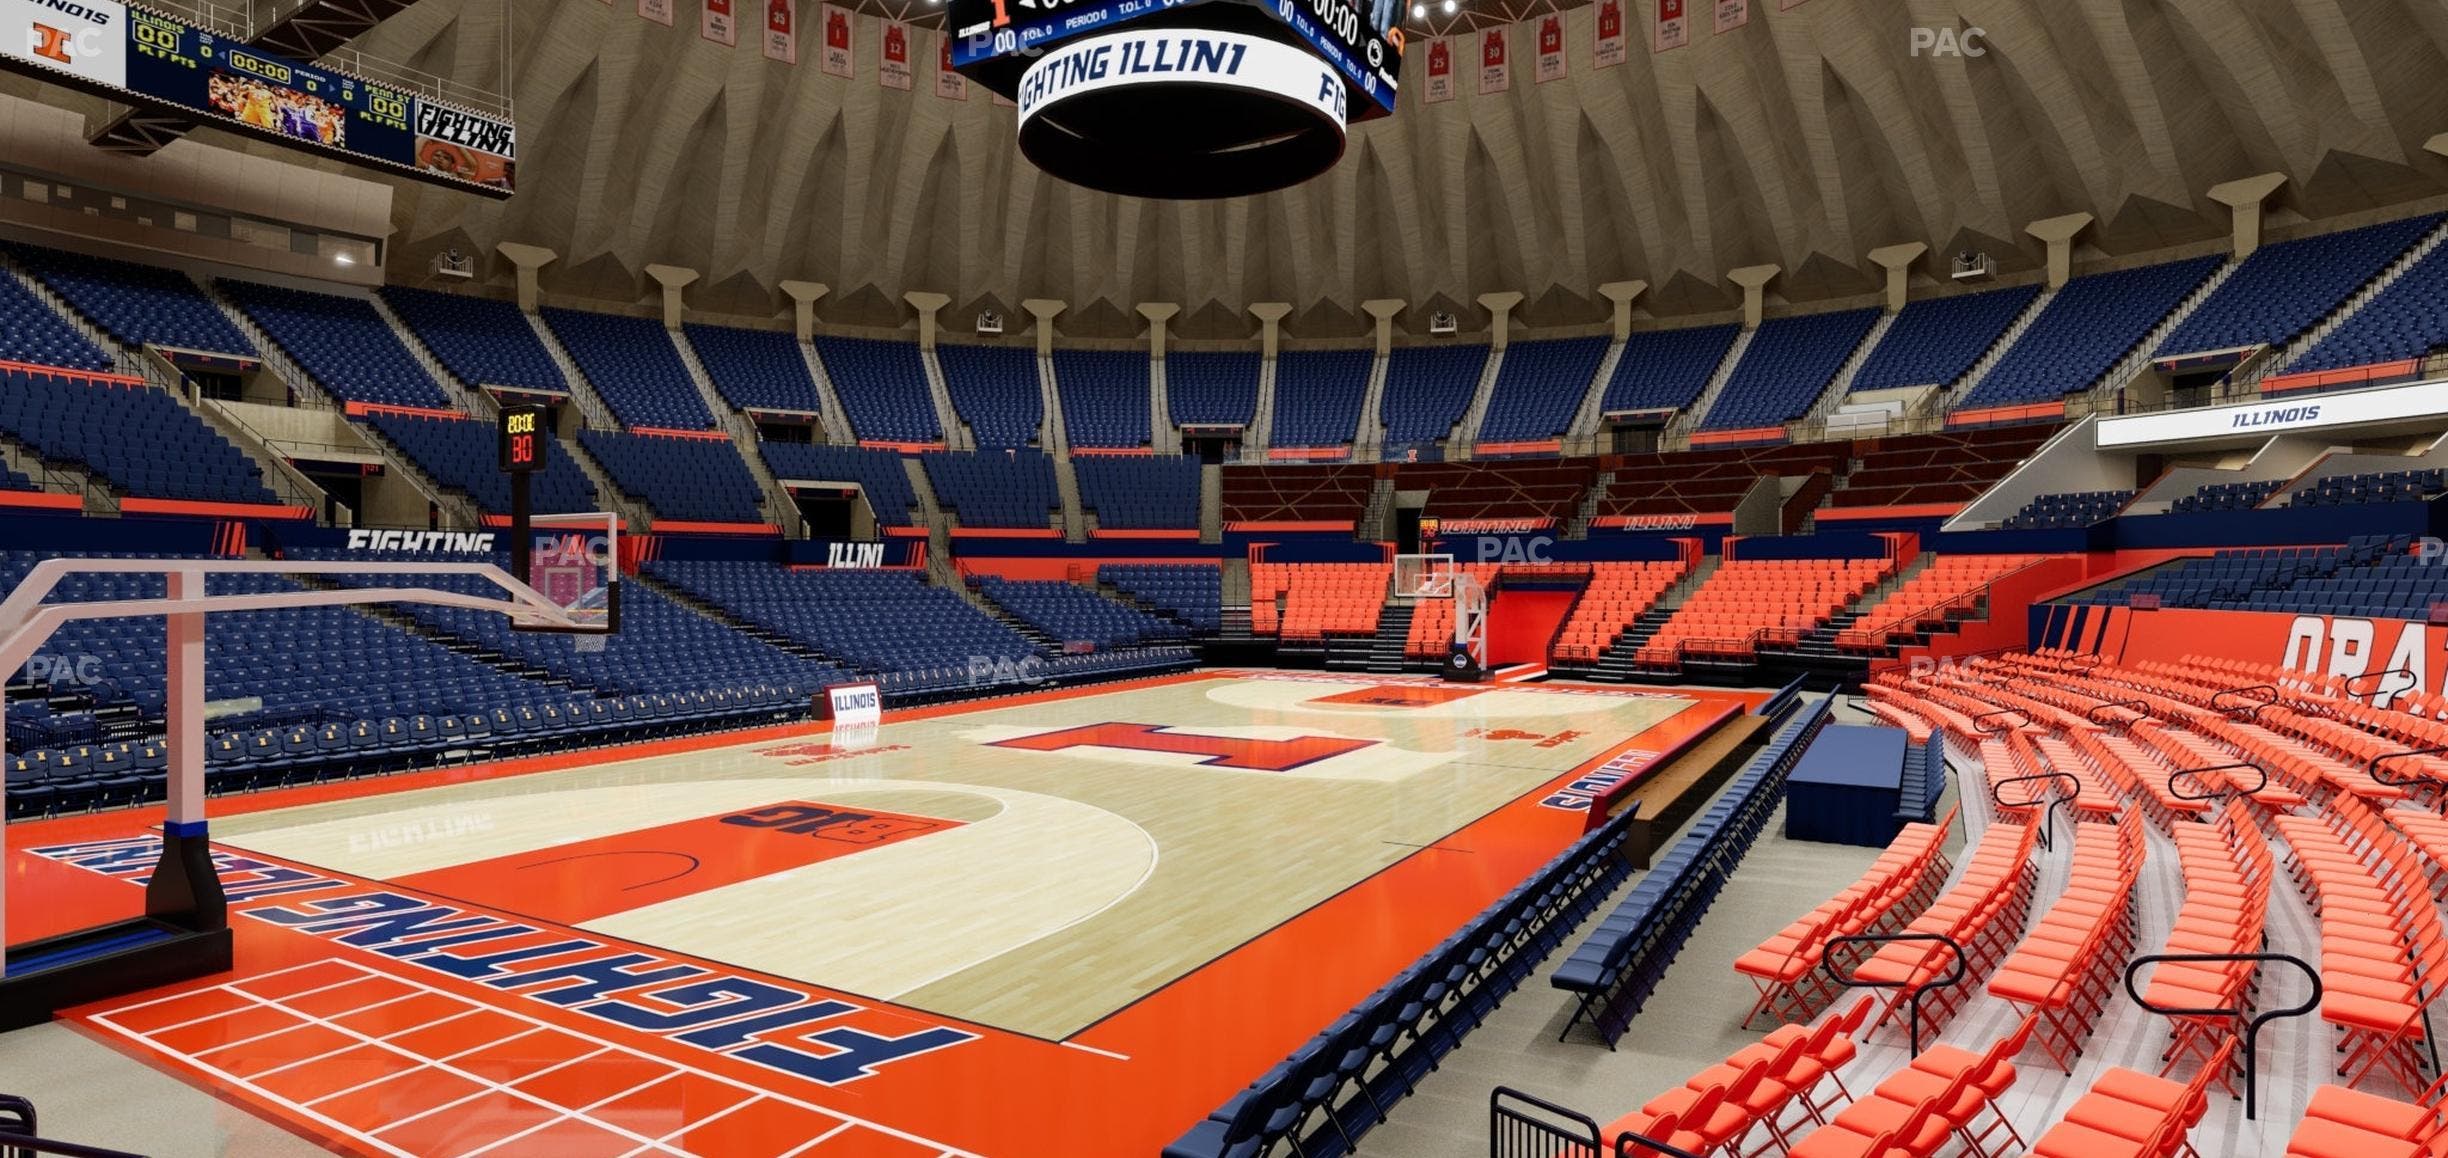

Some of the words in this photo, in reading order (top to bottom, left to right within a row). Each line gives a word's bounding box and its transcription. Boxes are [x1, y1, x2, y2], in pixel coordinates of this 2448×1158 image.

[131, 10, 185, 34] ILLINOIS
[1065, 11, 1099, 29] PERIOD
[136, 23, 176, 49] 00
[995, 29, 1016, 52] 00
[233, 54, 288, 81] 00:00
[1119, 39, 1247, 76] ILLINI
[295, 69, 326, 82] PERIOD
[373, 97, 404, 118] 00
[2232, 405, 2321, 428] ILLINOIS
[1622, 514, 1698, 531] ILLINI
[347, 529, 496, 556] FIGHTING
[828, 543, 885, 569] ILLINI
[834, 693, 876, 712] ILLINOIS
[232, 891, 984, 1087] FIGHTING
